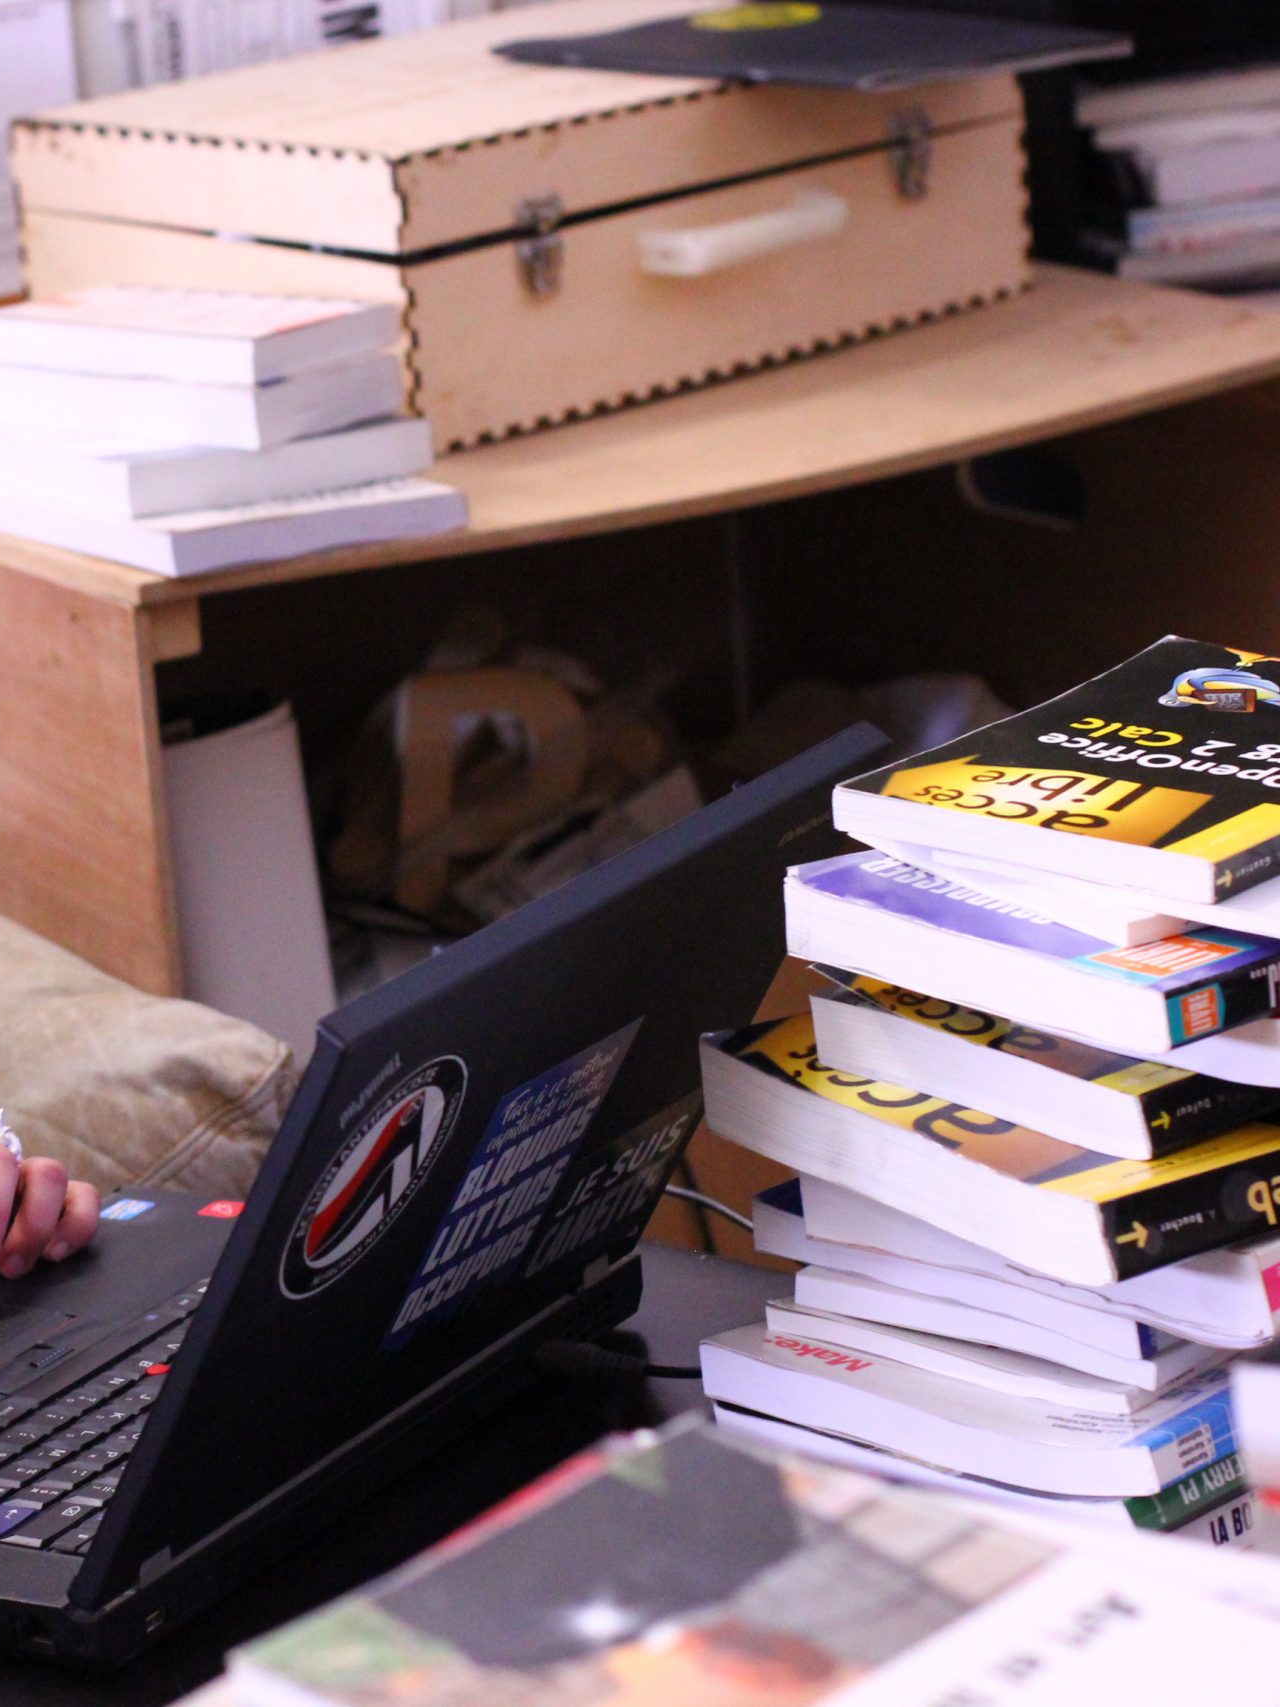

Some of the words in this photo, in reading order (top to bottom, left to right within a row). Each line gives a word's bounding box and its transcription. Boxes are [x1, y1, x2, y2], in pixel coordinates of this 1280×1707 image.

[1070, 716, 1183, 748] Calc
[1191, 740, 1237, 757] 2
[971, 769, 1137, 812] libre
[451, 1096, 601, 1213] BLOQUONS
[555, 1164, 608, 1218] JE
[604, 1114, 690, 1188] SUIS
[421, 1155, 571, 1276] LUTTONS
[391, 1214, 542, 1333] OCCUPONS
